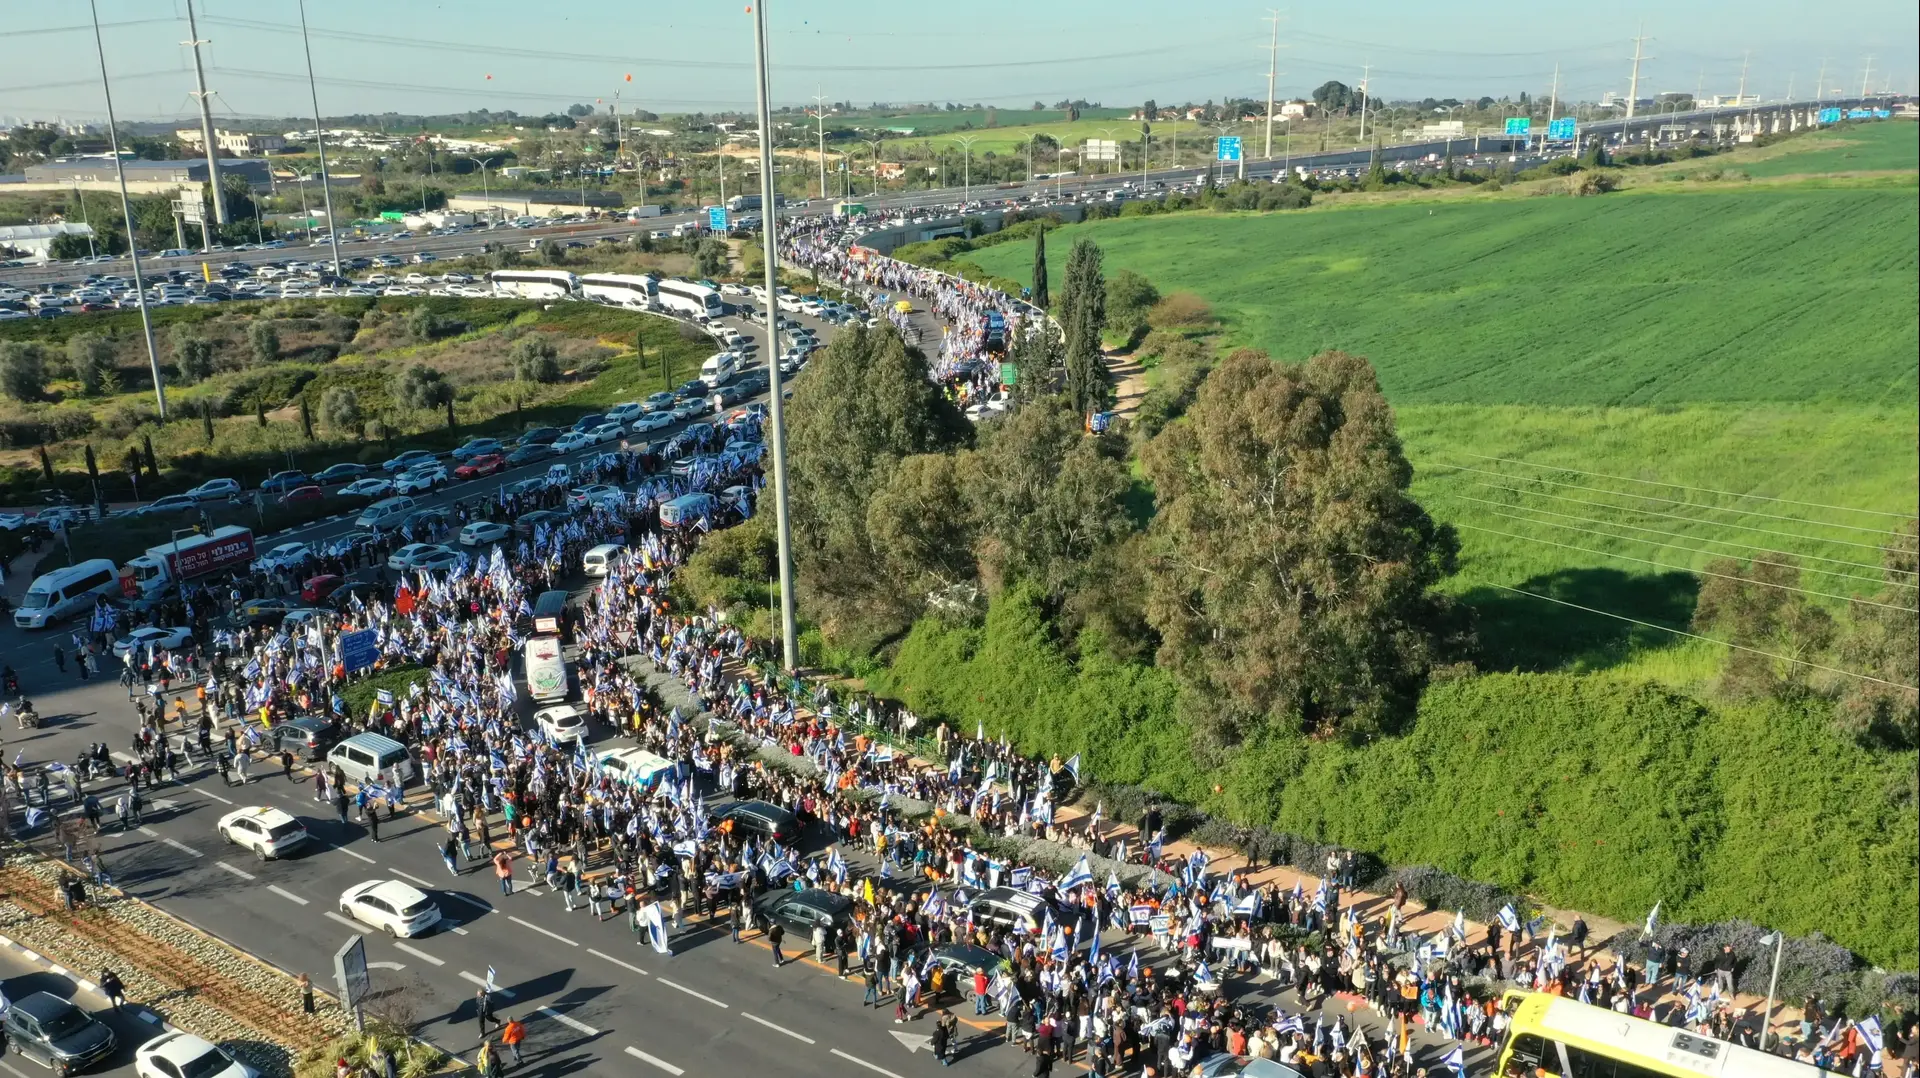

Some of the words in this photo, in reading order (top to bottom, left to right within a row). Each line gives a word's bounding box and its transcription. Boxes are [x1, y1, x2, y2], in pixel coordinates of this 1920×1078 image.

[211, 546, 223, 556] לוי
[224, 542, 240, 552] רמי
[196, 551, 207, 560] סל
